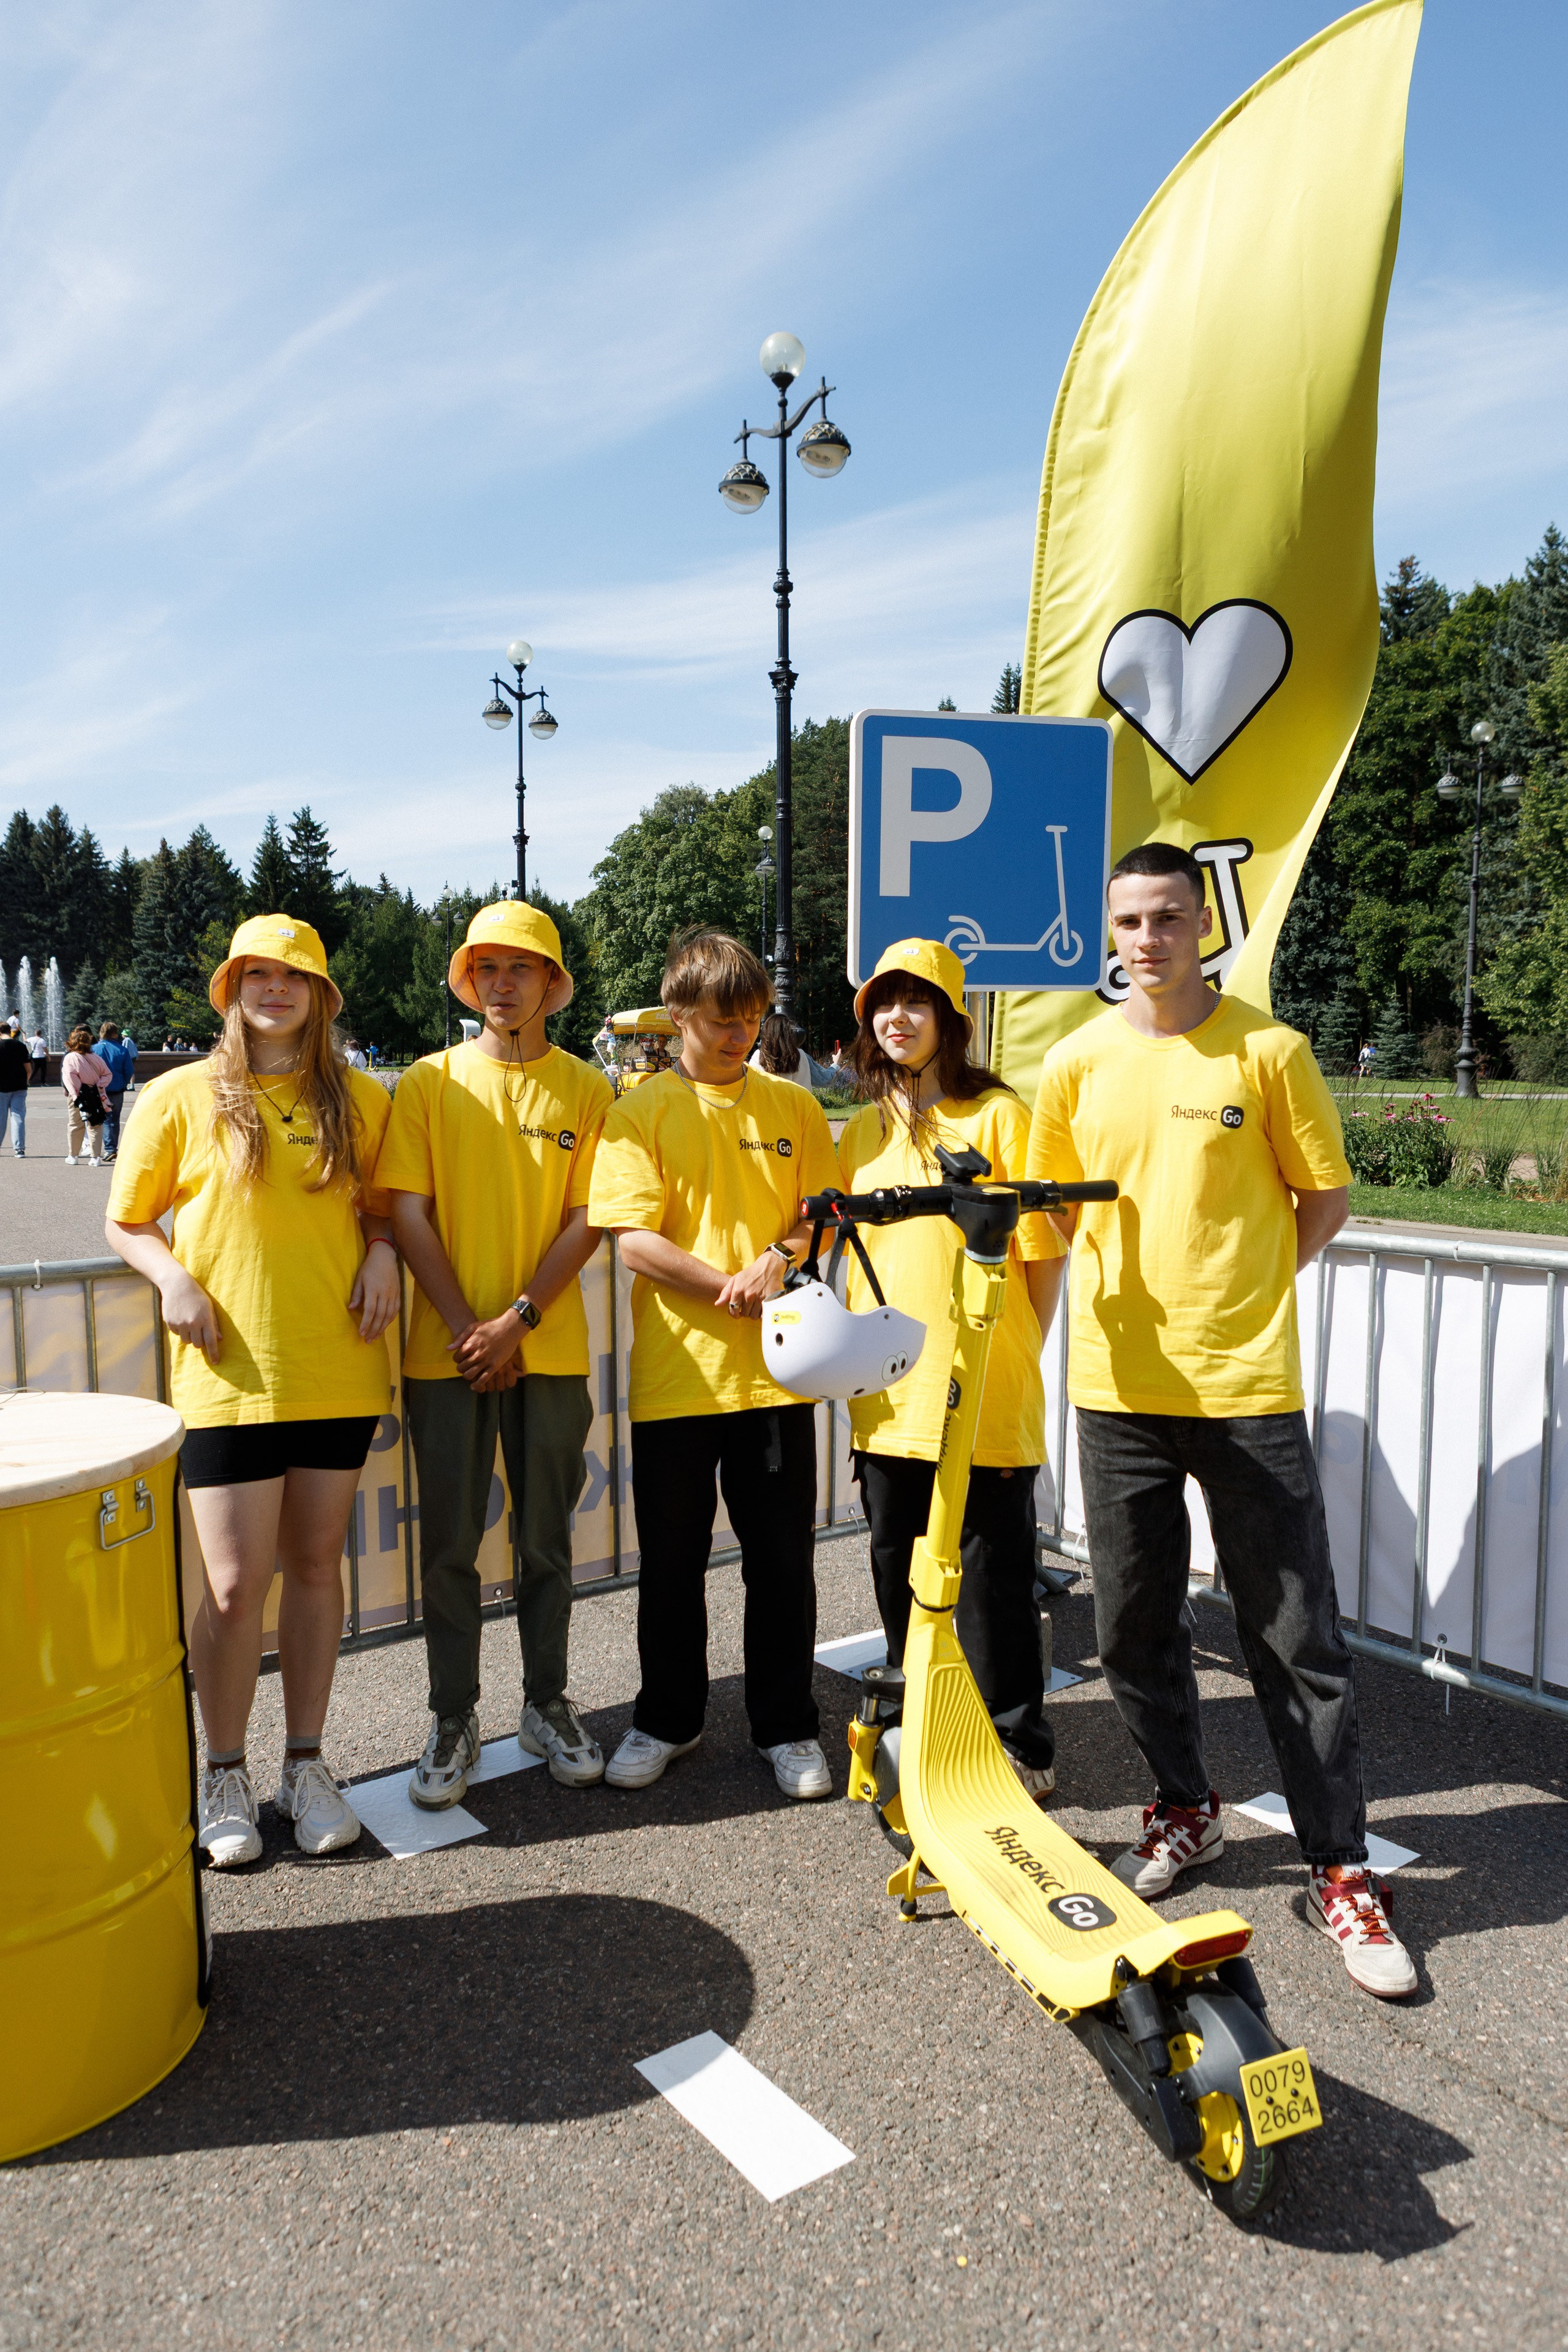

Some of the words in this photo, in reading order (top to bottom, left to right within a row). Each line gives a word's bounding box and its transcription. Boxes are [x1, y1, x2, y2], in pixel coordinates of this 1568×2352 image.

[879, 735, 992, 897] P
[1170, 1105, 1218, 1121] Яндекс
[1222, 1109, 1242, 1125] Go
[518, 1124, 557, 1142] Яндекс
[560, 1133, 575, 1148] Go
[739, 1138, 775, 1152] Яндекс
[778, 1141, 791, 1155] Go
[984, 1826, 1066, 1893] Яндекс
[1058, 1896, 1099, 1928] Go
[1250, 2060, 1305, 2098] 0079
[1258, 2095, 1314, 2135] 2664
